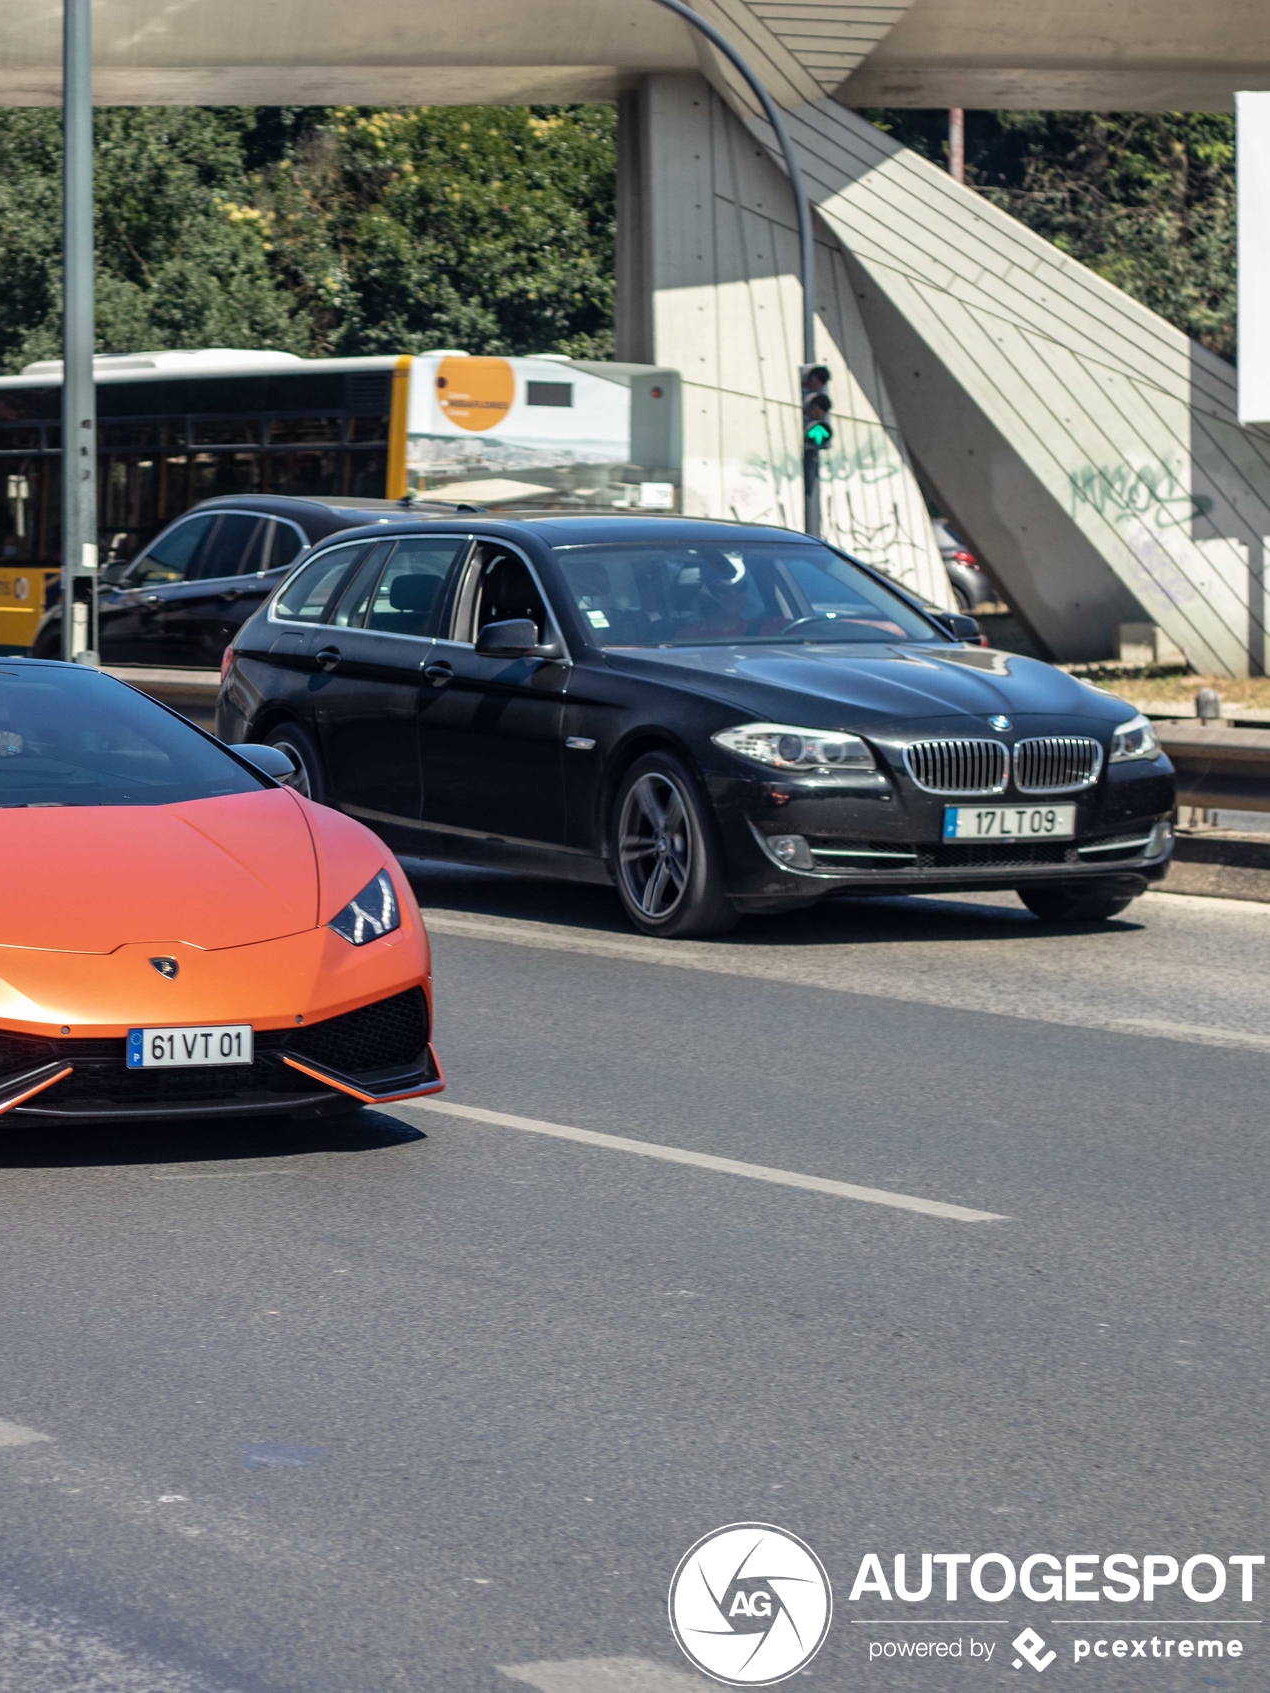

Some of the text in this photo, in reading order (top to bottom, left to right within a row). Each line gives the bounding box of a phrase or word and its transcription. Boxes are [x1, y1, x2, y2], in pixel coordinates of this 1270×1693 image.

[151, 1034, 174, 1060] 61
[182, 1033, 213, 1059] VT
[220, 1032, 242, 1057] 01
